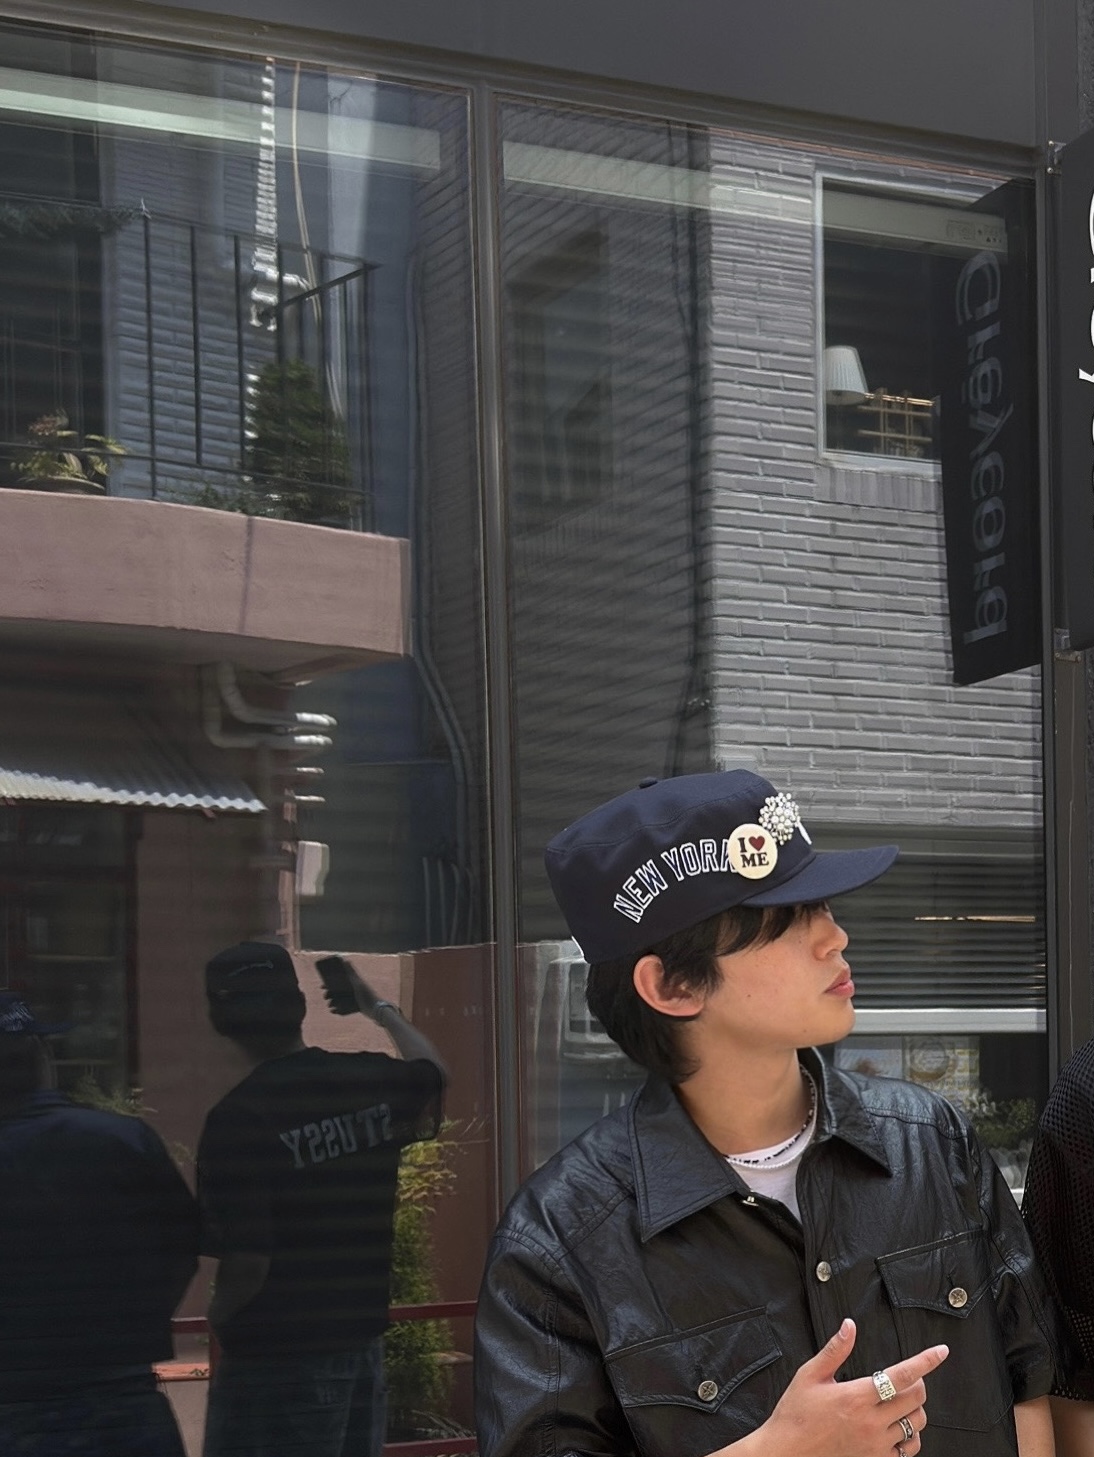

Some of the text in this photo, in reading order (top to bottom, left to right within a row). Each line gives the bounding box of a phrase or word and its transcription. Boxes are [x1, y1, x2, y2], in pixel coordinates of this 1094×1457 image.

[737, 836, 748, 854] I
[740, 852, 770, 868] ME
[613, 858, 669, 923] NEW
